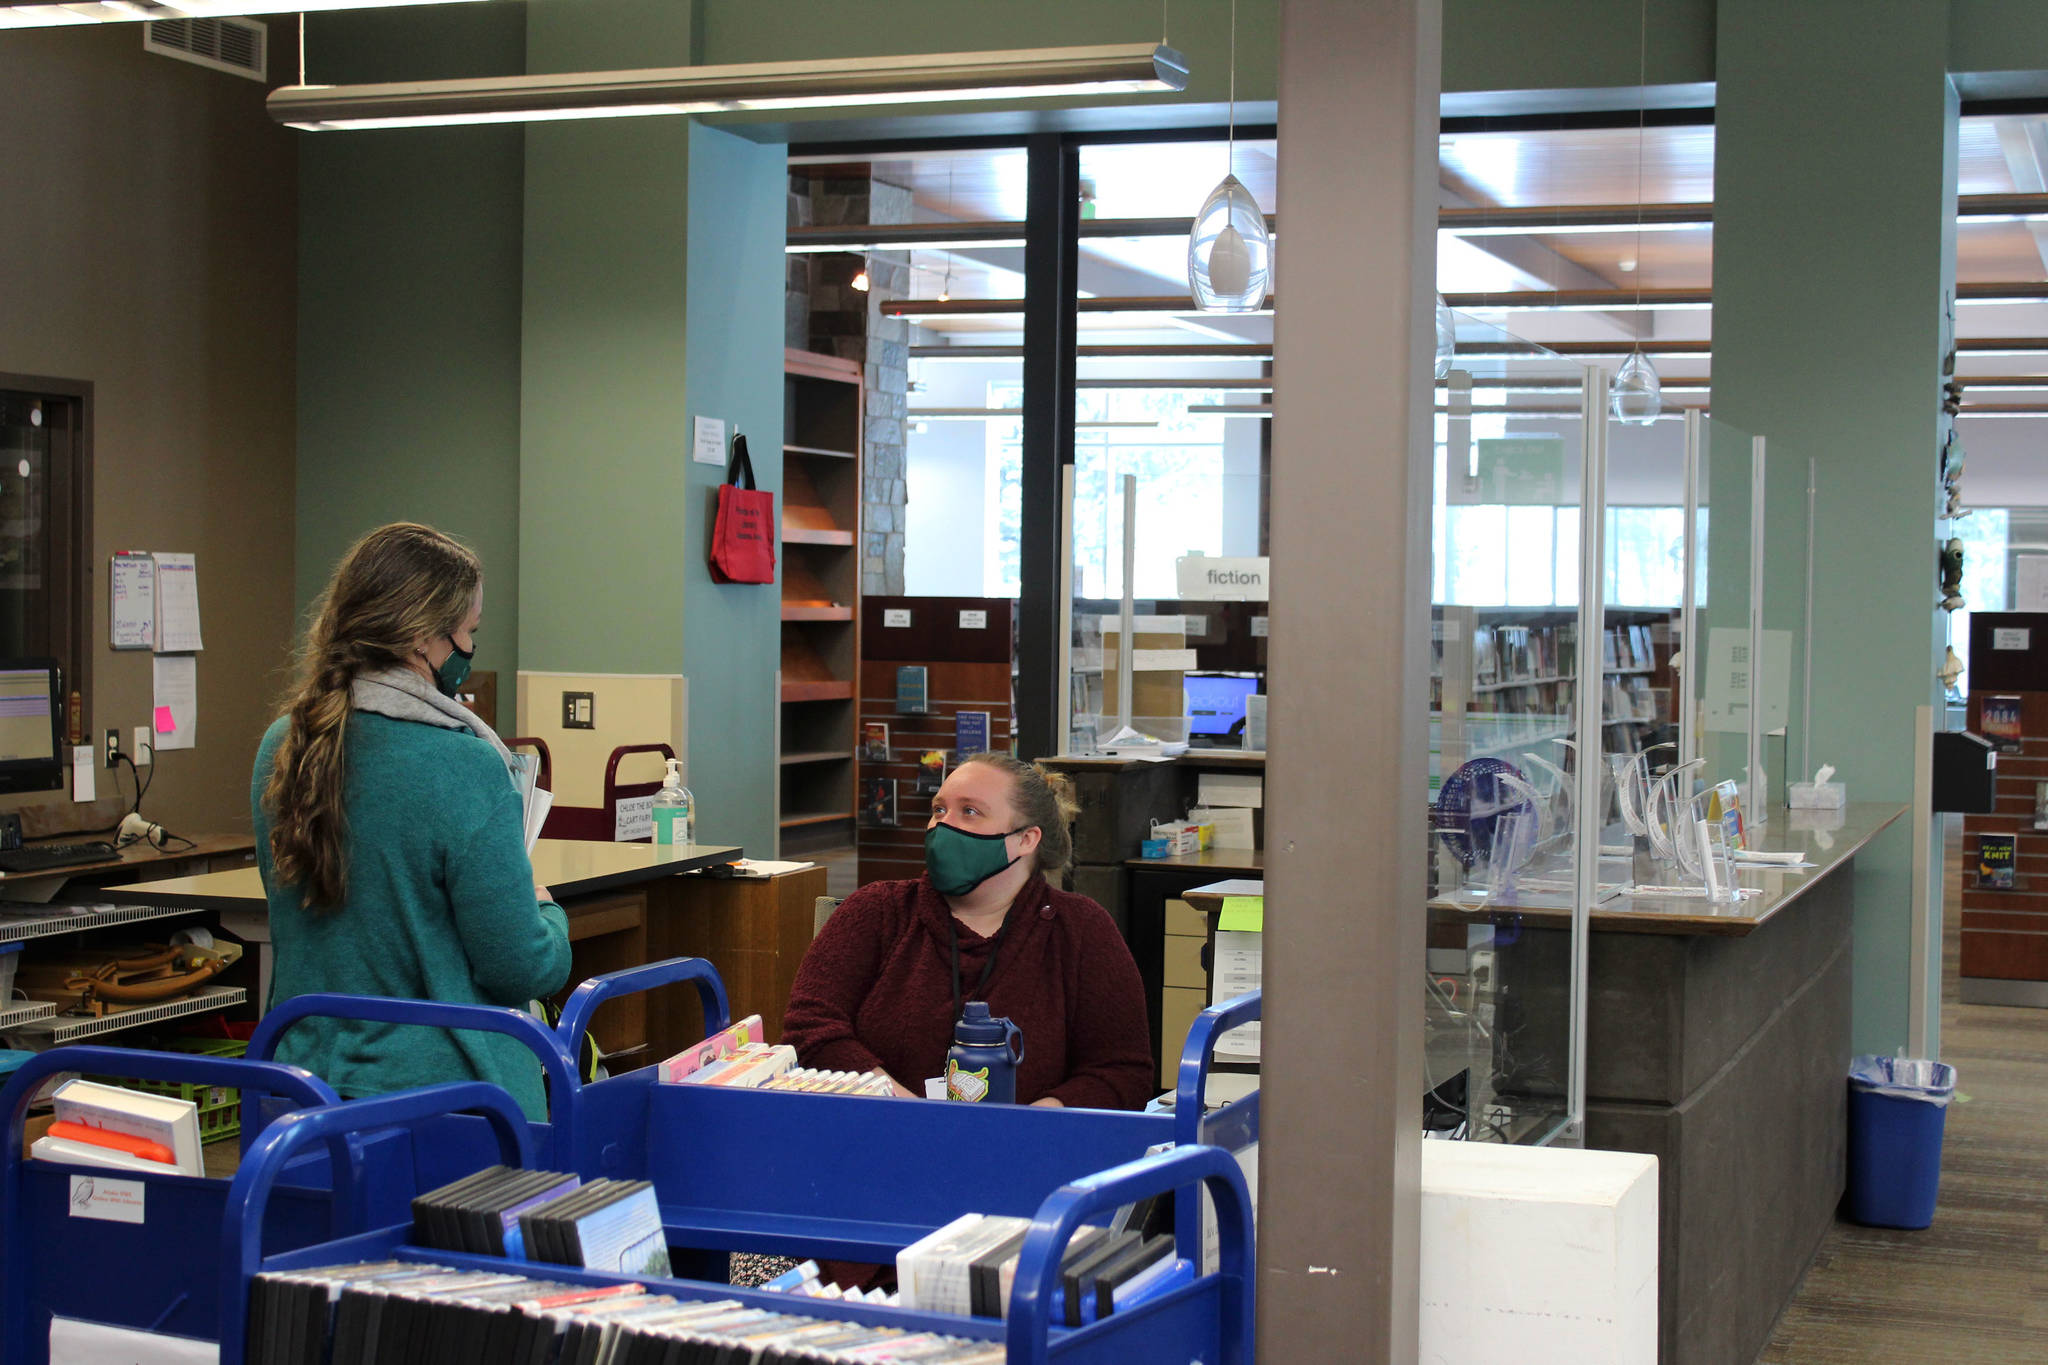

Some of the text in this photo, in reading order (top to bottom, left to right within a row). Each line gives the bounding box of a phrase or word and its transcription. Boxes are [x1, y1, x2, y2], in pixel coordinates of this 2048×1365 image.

[1207, 568, 1261, 585] fiction
[1191, 695, 1239, 707] eckout
[1985, 710, 2017, 723] 2084
[1983, 851, 2010, 860] KNIT
